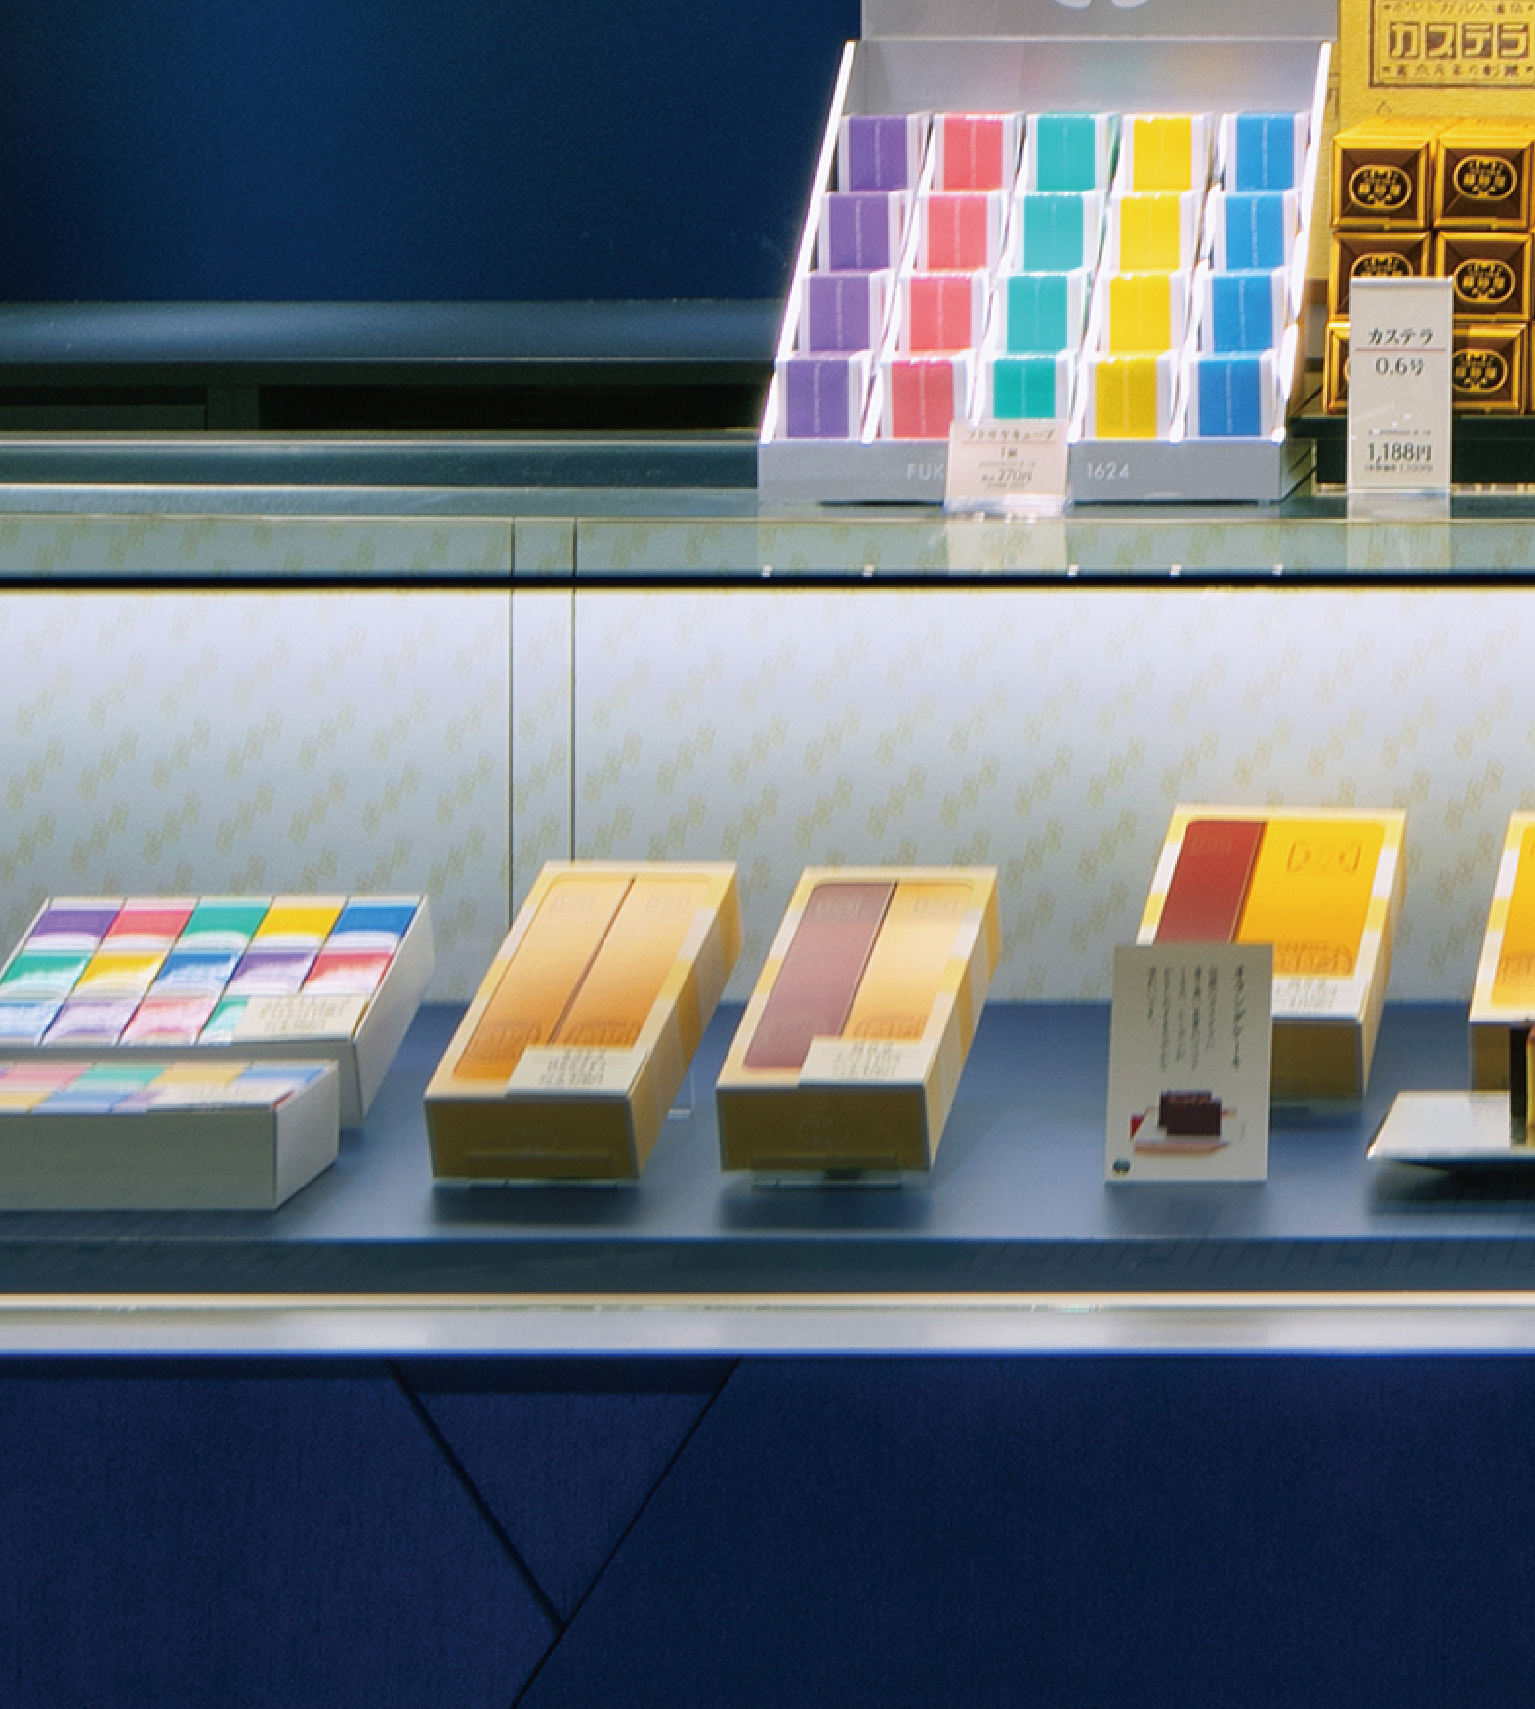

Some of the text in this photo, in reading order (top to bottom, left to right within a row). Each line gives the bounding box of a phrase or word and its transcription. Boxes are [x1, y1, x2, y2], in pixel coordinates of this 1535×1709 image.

[1390, 21, 1529, 59] カステラ
[1369, 327, 1434, 346] カステラ
[1375, 357, 1424, 376] 0.6号
[1367, 443, 1432, 464] 1,188円
[1086, 462, 1130, 480] 1624
